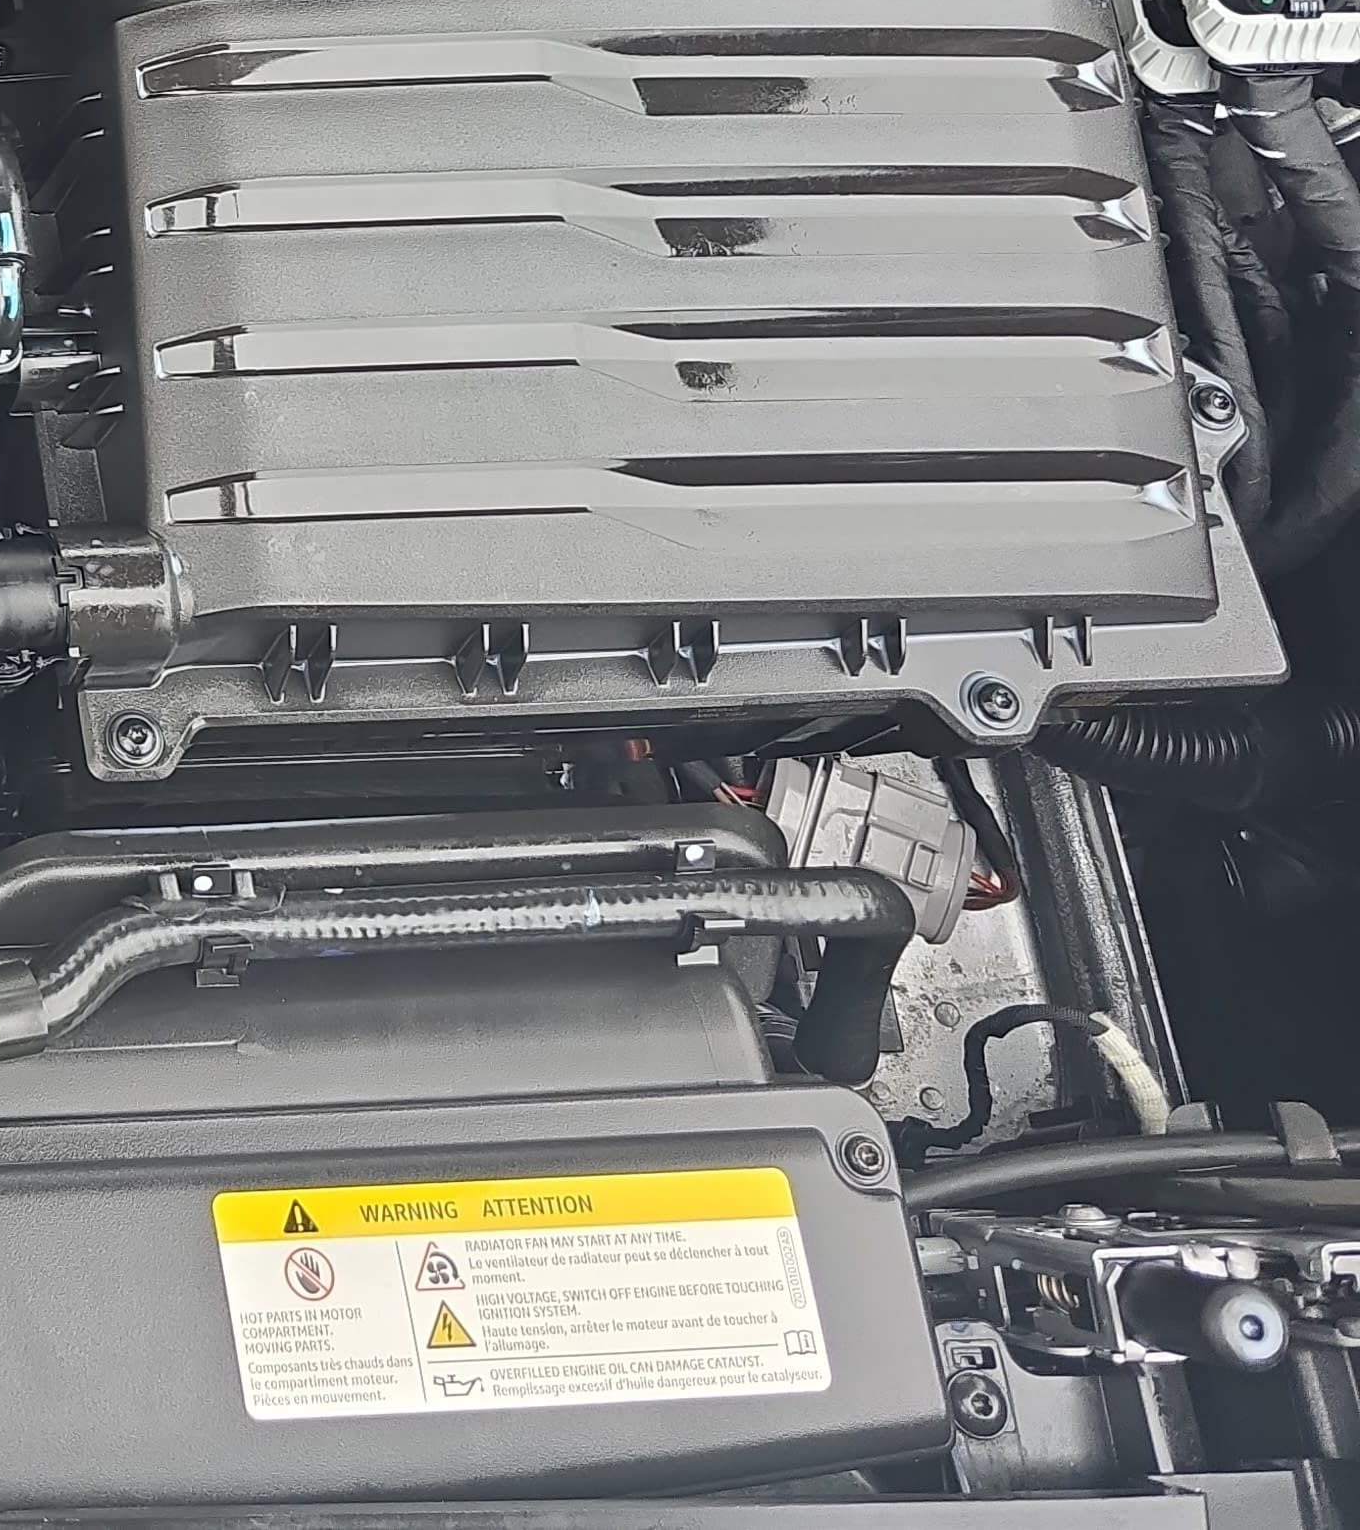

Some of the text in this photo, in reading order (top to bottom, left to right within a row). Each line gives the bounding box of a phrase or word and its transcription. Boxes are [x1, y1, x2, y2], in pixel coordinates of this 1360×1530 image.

[359, 1194, 593, 1223] WARNING ATTENTION
[464, 1230, 686, 1252] RADIATOR FAN MAY START AT ANY TIME.
[468, 1244, 769, 1270] Le ventilateur de radiateur peut se déclencher à tout
[471, 1271, 525, 1285] moment.
[475, 1279, 784, 1306] HIGH VOLTAGE, SWITCH OFF ENGINE BEFORE TOUCHING
[239, 1307, 362, 1325] HOT PARTS IN MOTOR
[478, 1303, 581, 1320] IGNITION SYSTEM.
[242, 1323, 334, 1340] COMPARTMENT.
[244, 1338, 335, 1355] MOVING PARTS.
[489, 1355, 764, 1381] OVERFILLED ENGINE OIL CAN DAMAGE CATALYST.
